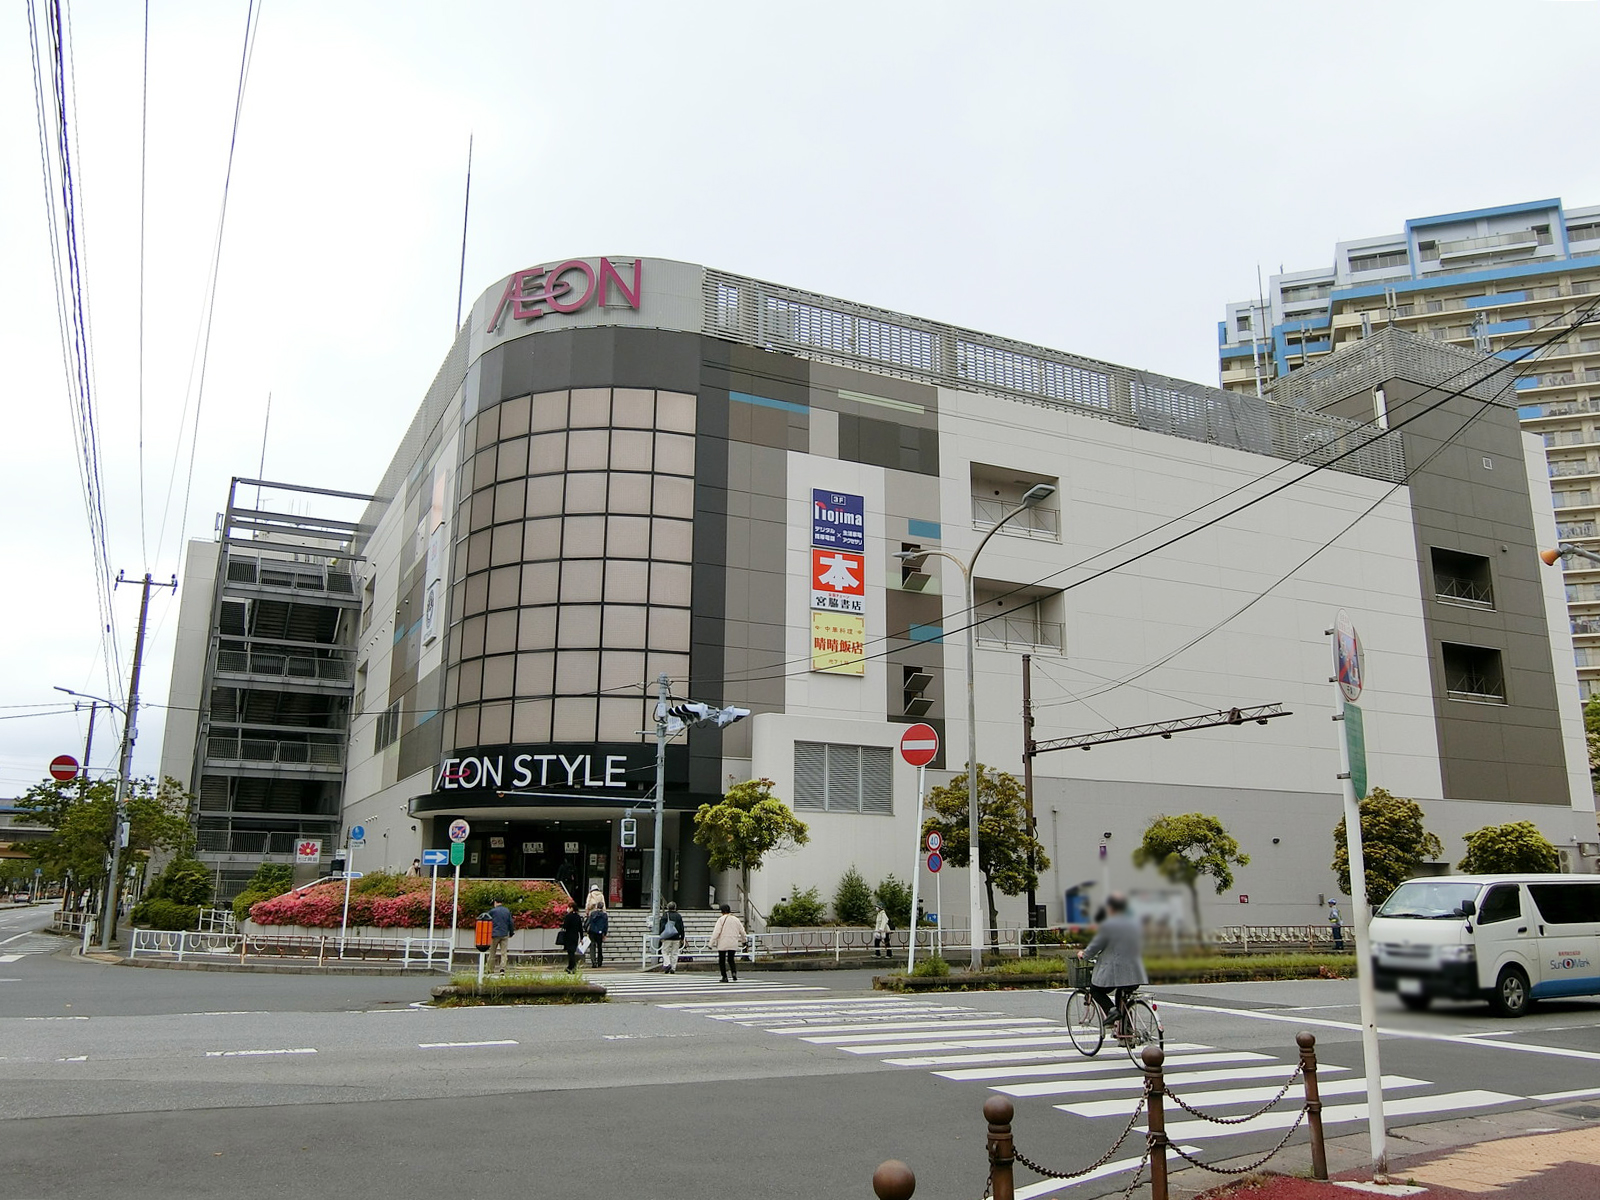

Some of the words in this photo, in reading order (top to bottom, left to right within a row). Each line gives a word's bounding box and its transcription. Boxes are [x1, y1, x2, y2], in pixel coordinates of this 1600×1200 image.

[815, 501, 862, 526] nojima
[818, 554, 860, 591] 本
[815, 596, 862, 611] 宮脇書店
[824, 626, 853, 635] 中華料理
[814, 637, 864, 655] 晴晴飯店
[512, 754, 628, 787] STYLE
[930, 836, 938, 845] 40
